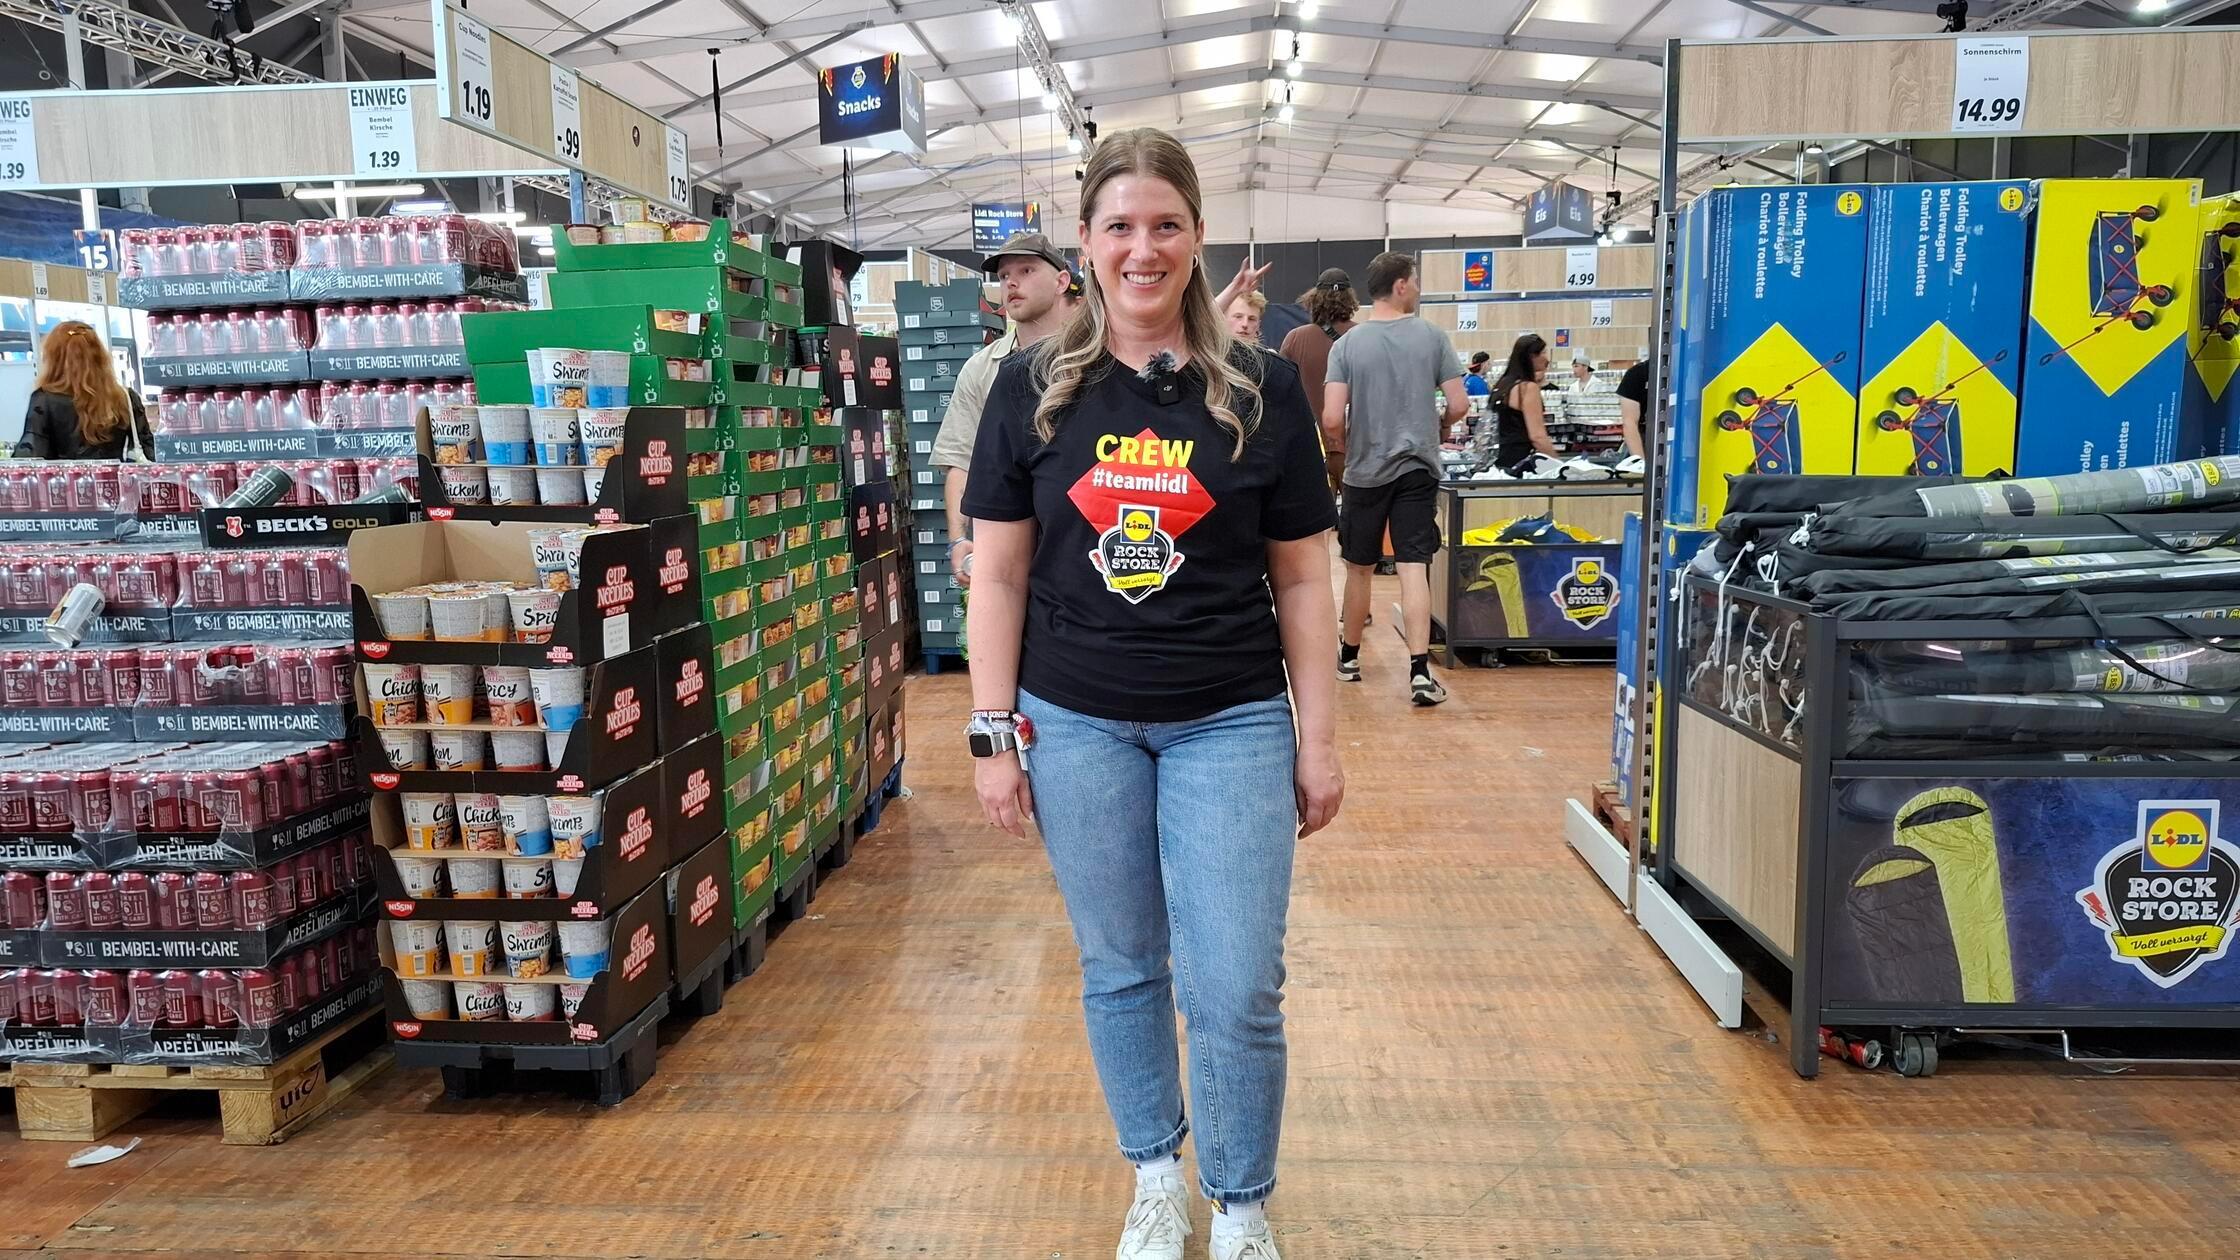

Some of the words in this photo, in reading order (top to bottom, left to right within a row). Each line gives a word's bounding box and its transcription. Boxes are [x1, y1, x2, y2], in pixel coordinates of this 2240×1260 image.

[1963, 48, 2022, 56] Sonnenschirm
[350, 87, 407, 107] EINWEG
[463, 80, 491, 120] 1.19
[838, 94, 882, 118] Snacks
[1958, 98, 2021, 122] 14.99
[557, 127, 580, 159] -.99
[369, 151, 400, 168] 1.39
[0, 163, 25, 179] .39
[671, 175, 687, 203] 1.79
[975, 209, 987, 217] Lidl
[1534, 209, 1547, 223] Eis
[1569, 206, 1582, 222] Eis
[1758, 192, 1771, 236] Chariot
[1793, 191, 1808, 235] Folding
[1920, 188, 1933, 232] Chariot
[1954, 187, 1970, 233] Folding
[1773, 191, 1790, 265] Bollerwagen
[1934, 187, 1951, 262] Bollerwagen
[1918, 234, 1930, 242] à
[80, 246, 108, 270] 15
[1791, 238, 1806, 279] Trolley
[1952, 235, 1968, 276] Trolley
[338, 270, 444, 289] BEMBEL-WITH-CARE
[1568, 273, 1595, 286] 4.99
[1755, 246, 1768, 299] roulettes
[1915, 244, 1928, 297] roulettes
[164, 279, 269, 297] BEMBEL-WITH-CARE
[1459, 321, 1477, 330] 7.99
[1592, 317, 1611, 326] 7.99
[187, 359, 290, 377] BEMBEL-WITH-CARE
[356, 353, 461, 370] BEMBEL-WITH-CARE
[202, 437, 306, 454] BEMBEL-WITH-CARE
[648, 440, 667, 457] CUP
[1096, 434, 1194, 468] CREW
[640, 456, 673, 476] NOODLES
[2080, 440, 2095, 473] rolley
[1092, 468, 1188, 494] #teamlidl
[430, 508, 452, 517] NISSIN
[256, 515, 328, 533] BECK'S
[333, 517, 379, 529] GOLD
[666, 548, 683, 567] CUP
[1113, 545, 1160, 558] ROCK
[1111, 558, 1160, 570] STORE
[606, 566, 627, 586] CUP
[659, 562, 689, 587] NOODLES
[597, 581, 635, 609] NOODLES
[1567, 596, 1606, 605] STORE
[1569, 586, 1606, 596] ROCK
[228, 614, 351, 630] BEMBEL-WITH-CARE
[363, 643, 389, 652] NISSIN
[682, 658, 698, 680] CUP
[676, 671, 704, 700] NOODLES
[614, 687, 634, 710] CUP
[192, 714, 320, 731] BEMBEL-WITH-CARE
[606, 701, 641, 734] NOODLES
[373, 773, 398, 783] NISSIN
[687, 768, 705, 791] CUP
[296, 800, 371, 841] BEMBEL-WITH-CAR
[627, 806, 646, 832] CUP
[696, 875, 713, 899] CUP
[2127, 877, 2217, 899] ROCK
[388, 903, 413, 912] NISSIN
[2121, 901, 2218, 921] STORE
[630, 923, 649, 951] CUP
[2131, 938, 2160, 951] Voll
[2160, 930, 2209, 949] versorgt
[102, 941, 240, 957] BEMBEL-WITH-CARE
[311, 977, 384, 1029] BEMBEL-WITH-CAR
[396, 1023, 420, 1033] NISSIN
